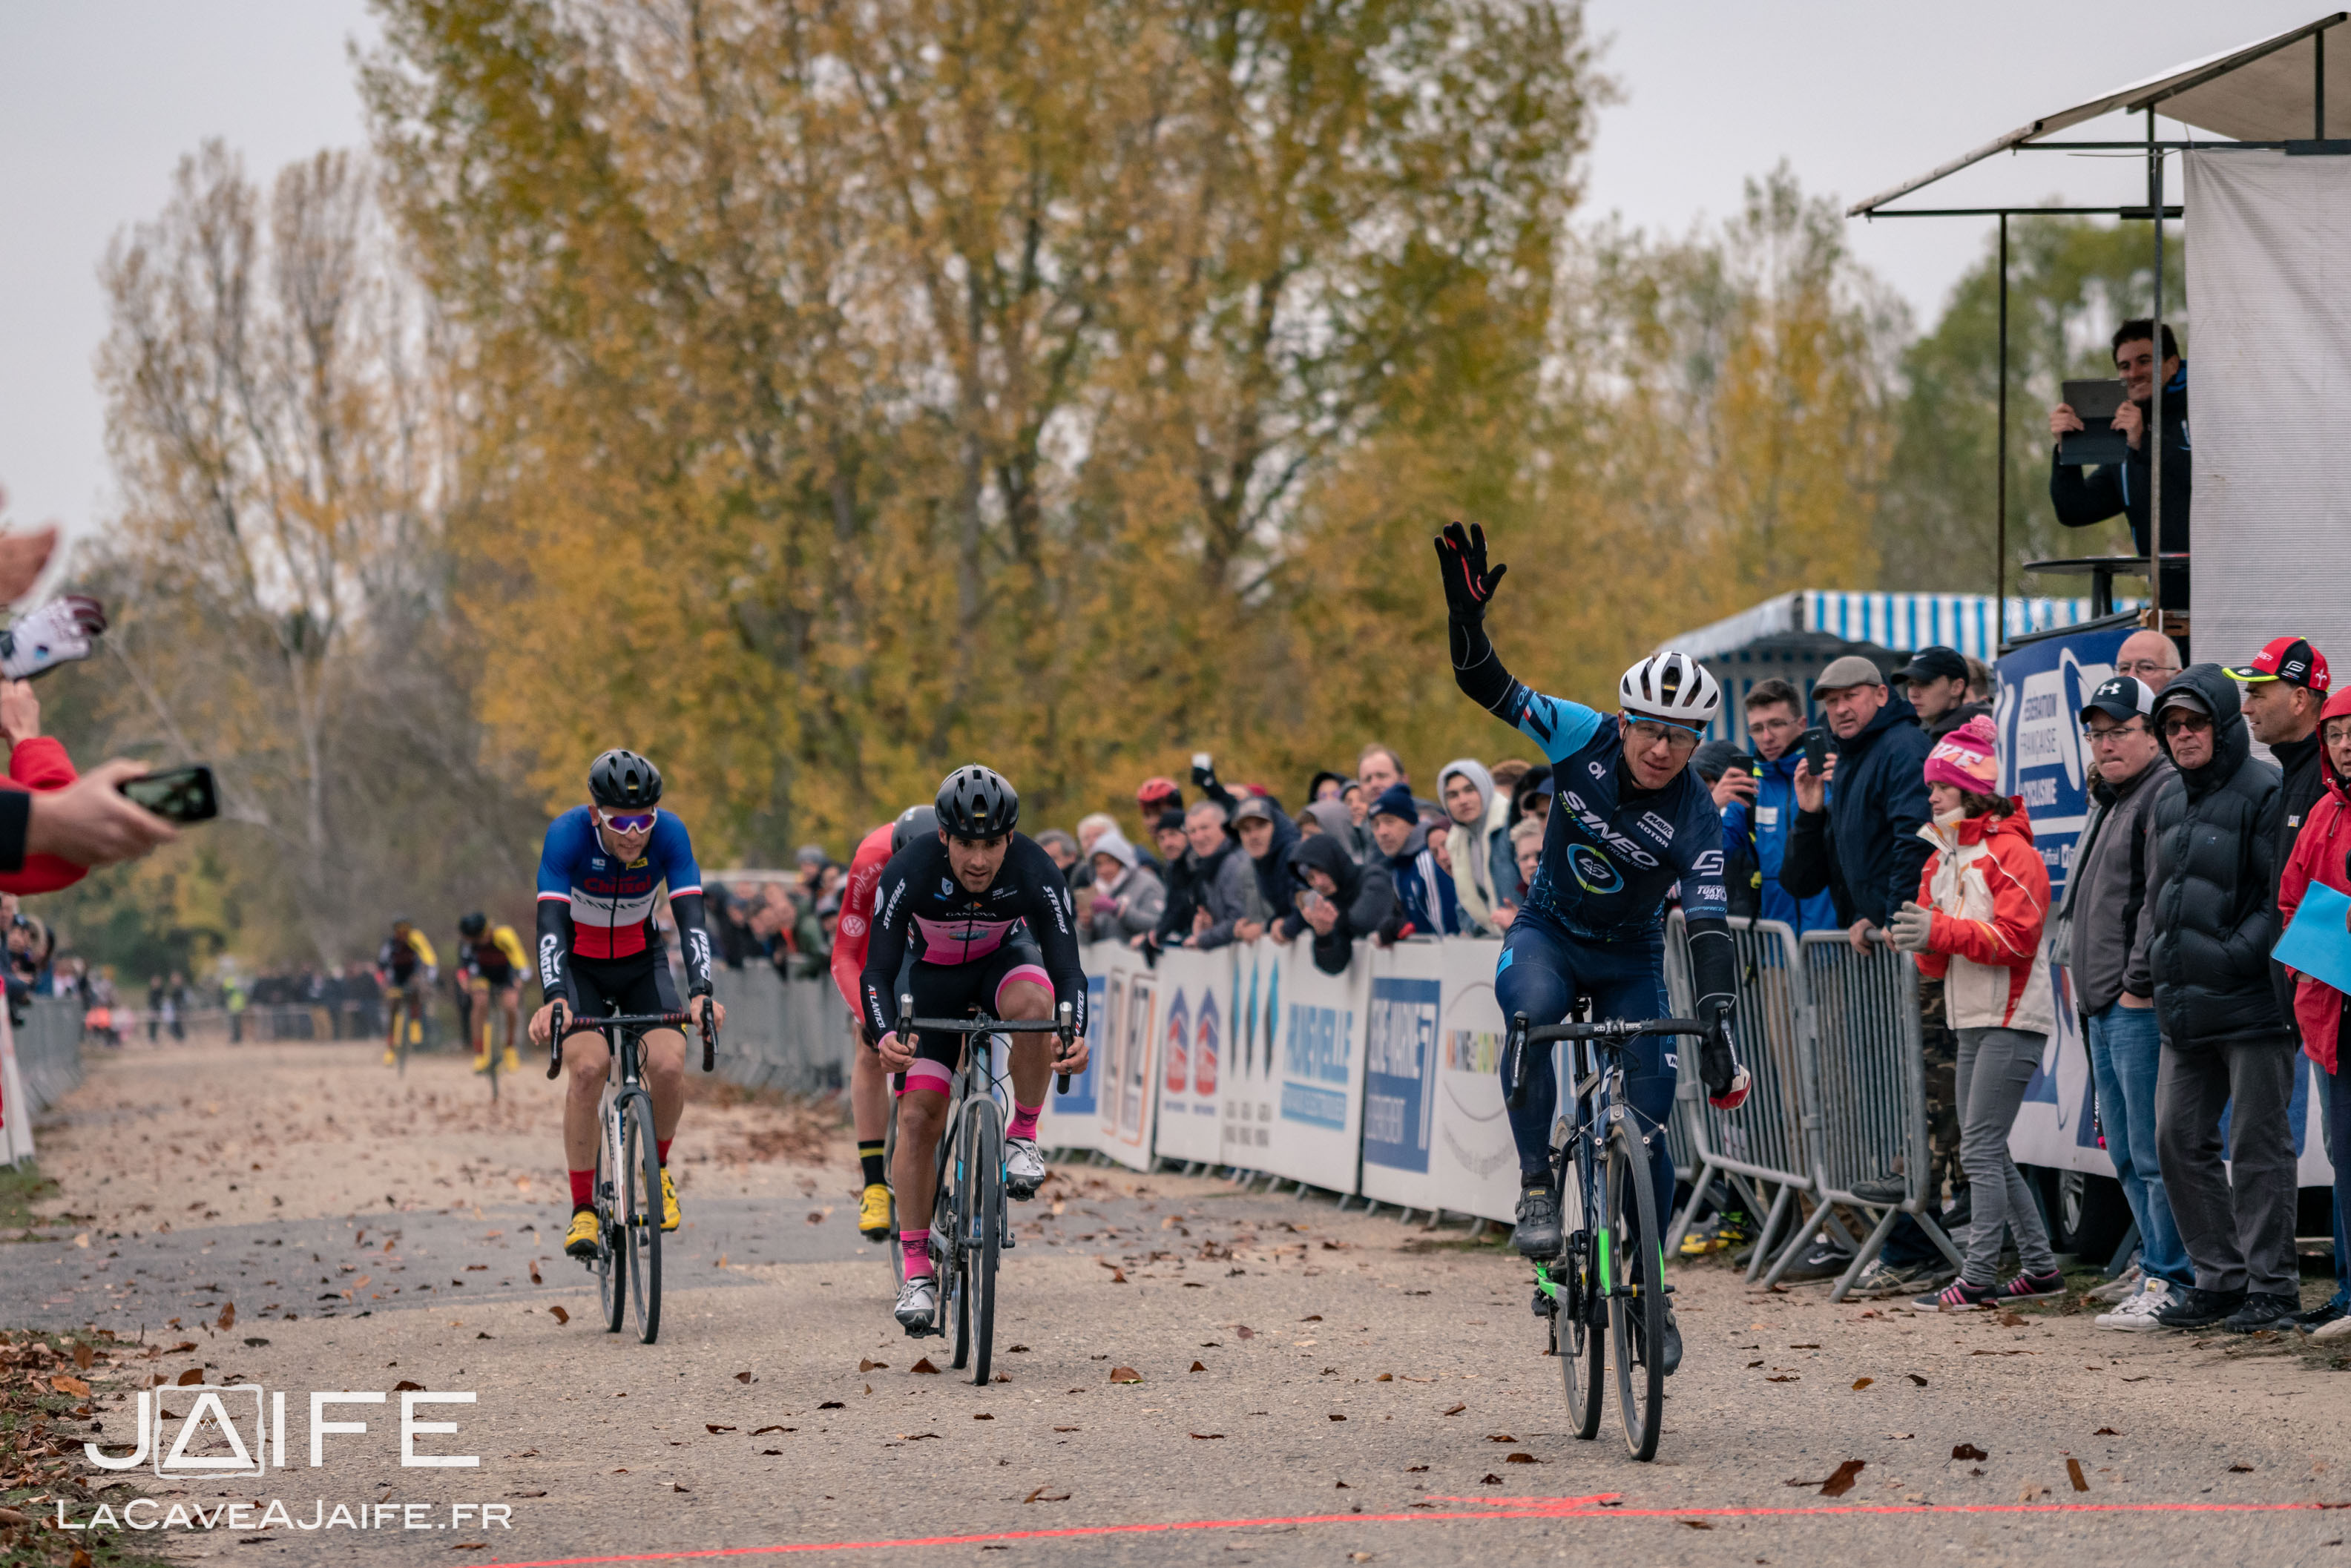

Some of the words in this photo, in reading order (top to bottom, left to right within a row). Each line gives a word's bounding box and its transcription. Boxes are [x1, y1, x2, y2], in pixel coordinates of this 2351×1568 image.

[1645, 814, 1674, 837] MAVIC
[1605, 844, 1632, 863] CYCLING
[883, 877, 907, 930] STEVENS
[1043, 885, 1069, 935] STEVENS
[540, 932, 560, 989] Chazal
[868, 984, 887, 1029] ATLANTICO
